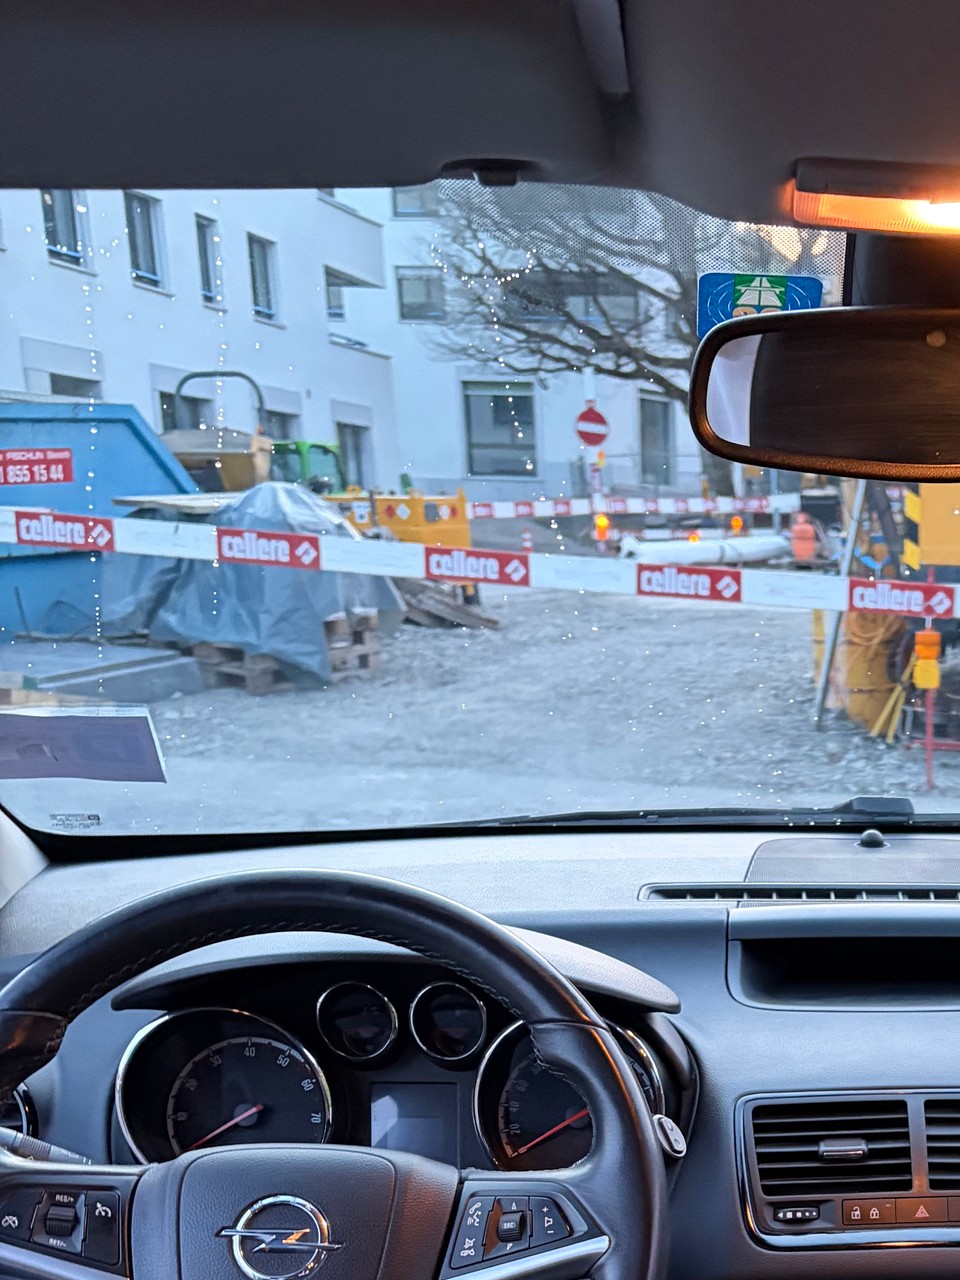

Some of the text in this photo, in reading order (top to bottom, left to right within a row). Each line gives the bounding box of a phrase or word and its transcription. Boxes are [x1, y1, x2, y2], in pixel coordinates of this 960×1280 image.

[7, 465, 30, 483] 855
[32, 465, 48, 482] 15
[50, 465, 64, 480] 44
[19, 516, 86, 543] cellere
[221, 532, 290, 561] cellere
[429, 552, 499, 580] cellere
[639, 568, 711, 596] cellere
[852, 584, 924, 611] cellere
[244, 1047, 255, 1057] 40
[210, 1055, 222, 1067] 30
[277, 1055, 289, 1067] 50
[301, 1078, 314, 1091] 60
[311, 1112, 321, 1123] 70
[510, 1124, 520, 1135] 20
